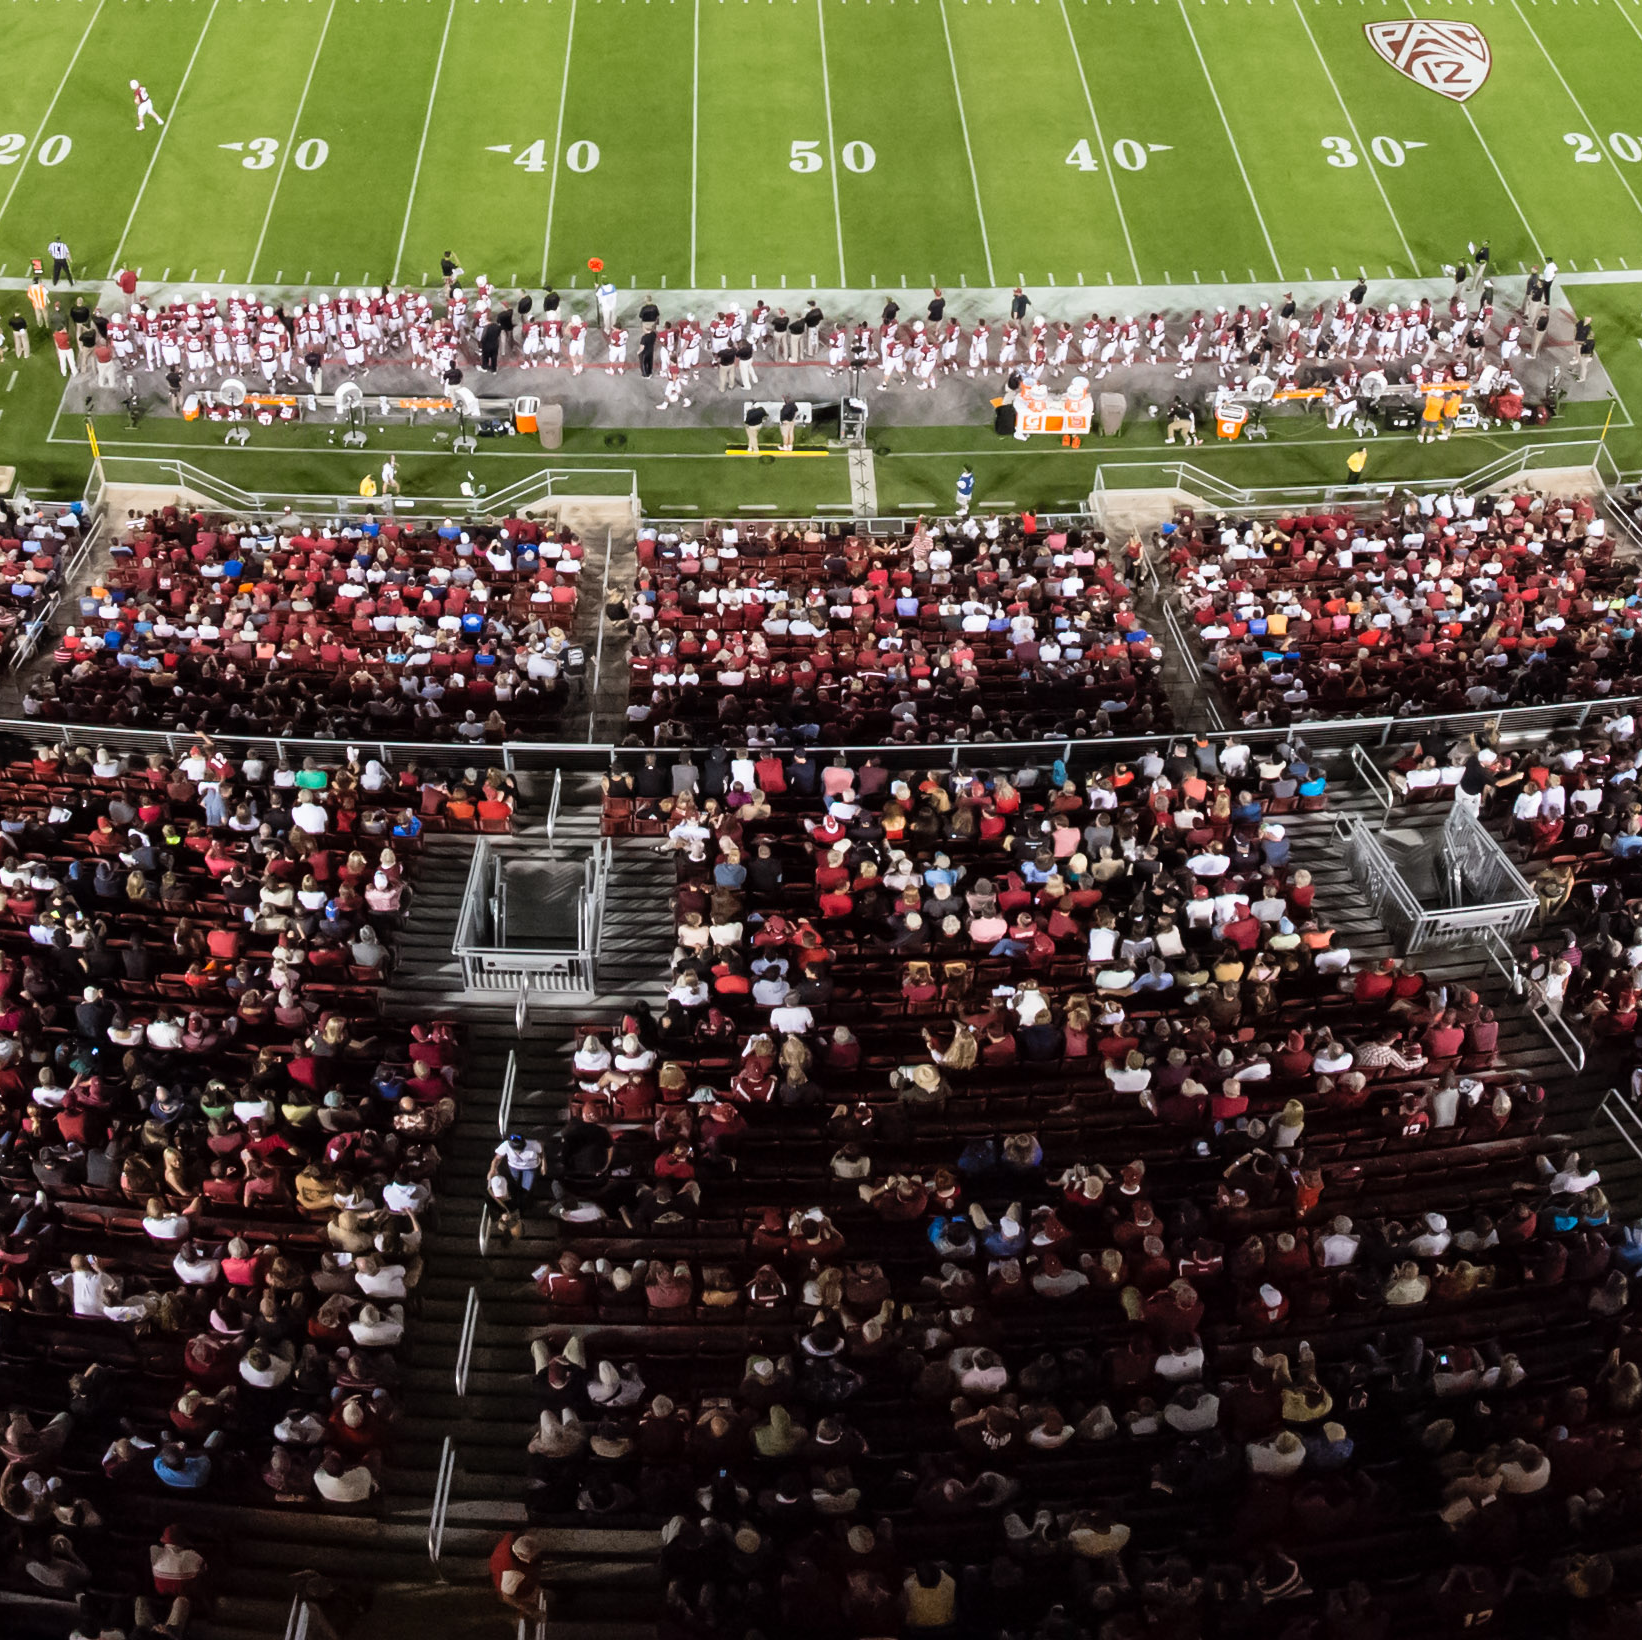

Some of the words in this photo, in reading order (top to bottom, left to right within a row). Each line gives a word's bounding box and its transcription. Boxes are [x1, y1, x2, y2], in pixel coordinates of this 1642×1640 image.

[1370, 21, 1489, 59] PAC
[1420, 60, 1475, 85] 12
[241, 136, 330, 171] 30
[513, 139, 601, 173] 40
[788, 139, 877, 174] 50
[1064, 138, 1149, 172] 40
[1321, 135, 1406, 169] 30
[1222, 423, 1235, 434] G
[210, 752, 228, 769] 12
[1402, 1123, 1421, 1137] 12
